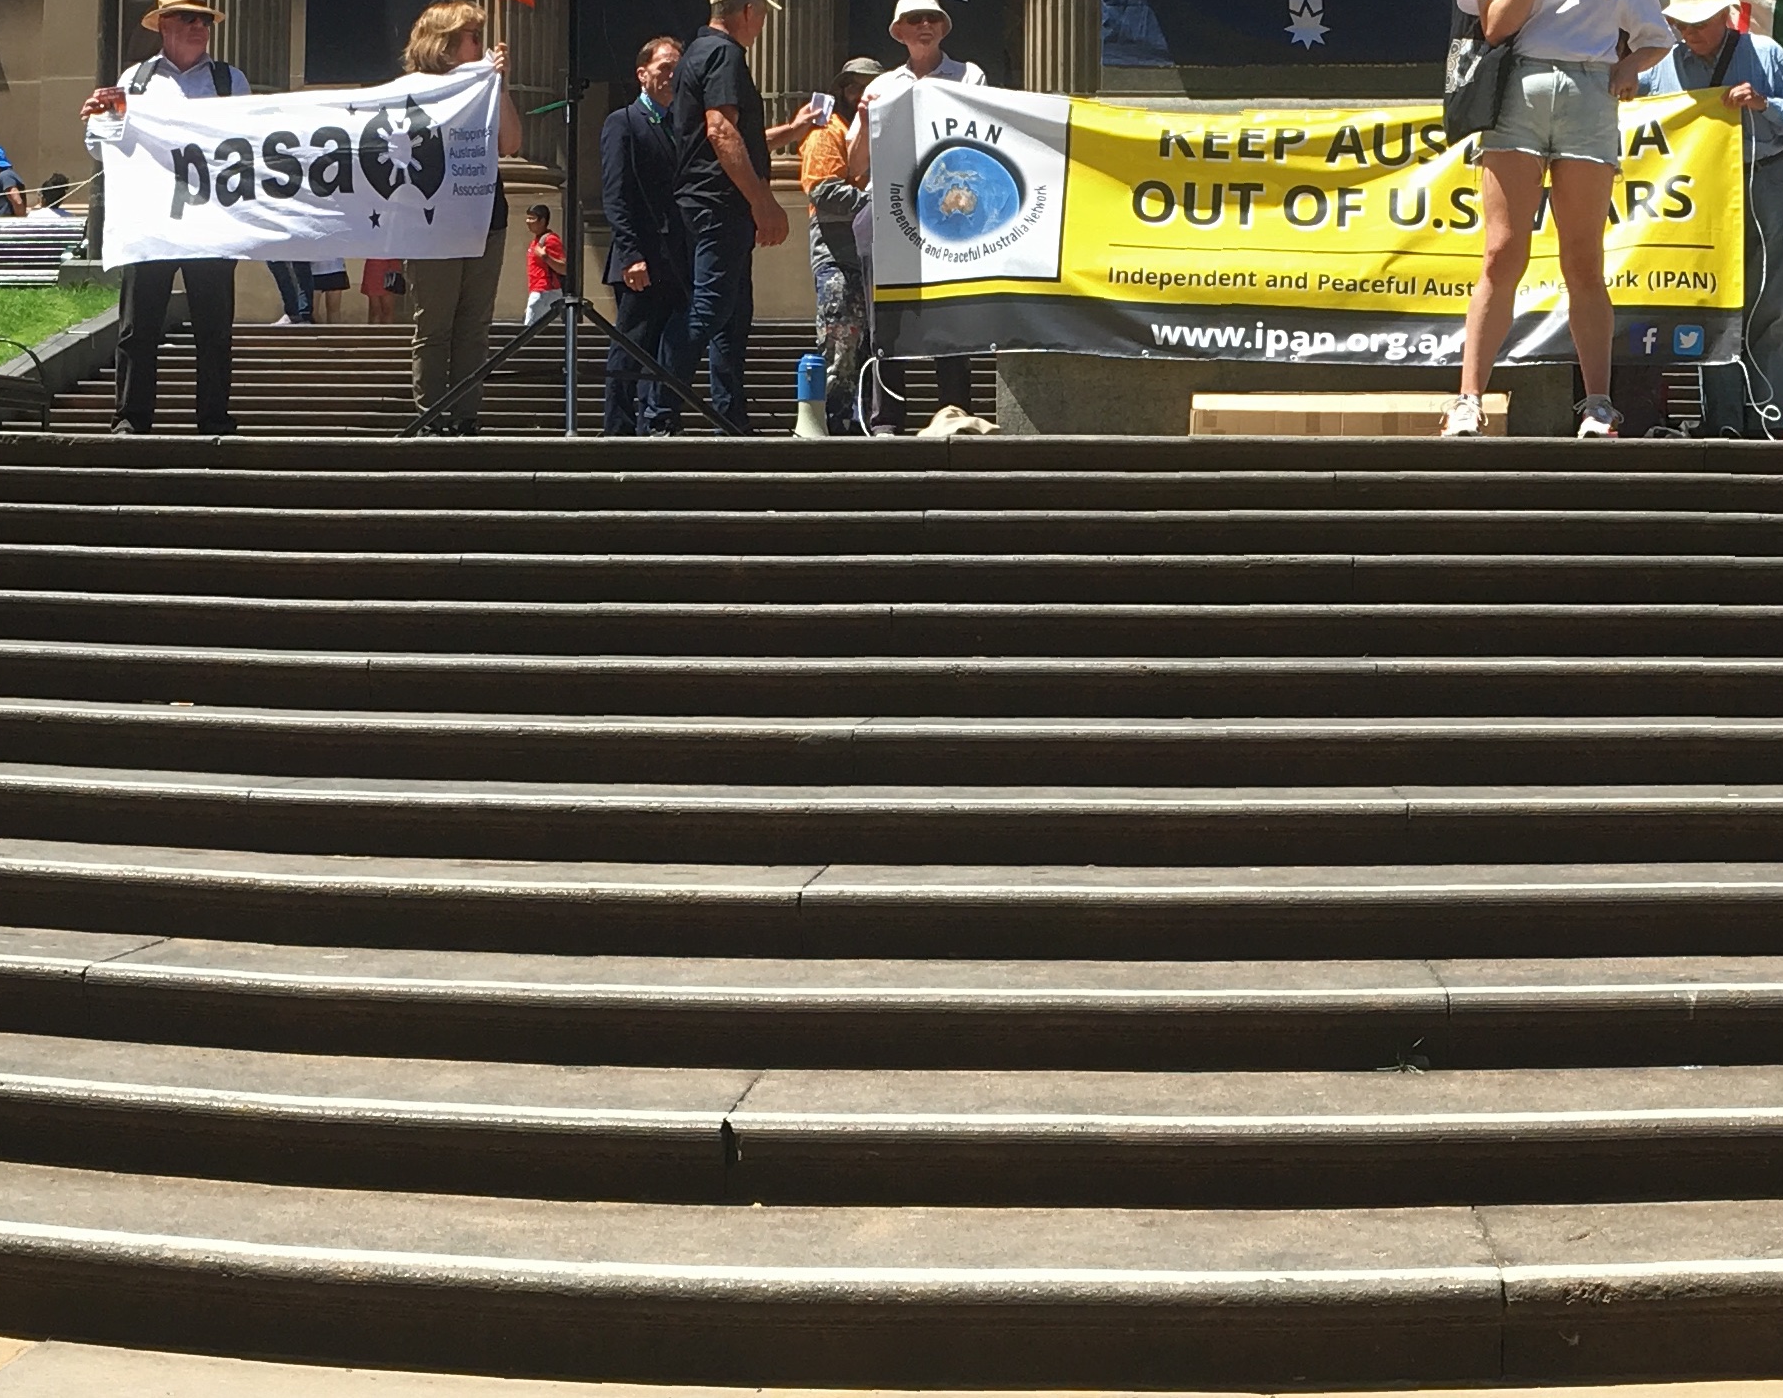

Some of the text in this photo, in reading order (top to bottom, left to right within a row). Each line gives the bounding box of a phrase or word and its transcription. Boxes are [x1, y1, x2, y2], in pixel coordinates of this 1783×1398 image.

[931, 118, 1003, 144] IPAN
[1159, 127, 1307, 160] KEEP
[449, 145, 486, 159] Australia
[170, 127, 355, 220] pasa
[1131, 180, 1265, 227] OUT
[1284, 184, 1364, 229] OF
[890, 182, 1047, 264] Independent and Peaceful Australia Network
[1108, 267, 1257, 290] Independent
[1265, 271, 1309, 290] and
[1318, 273, 1417, 295] Peaceful
[1647, 269, 1718, 294] (IPAN)
